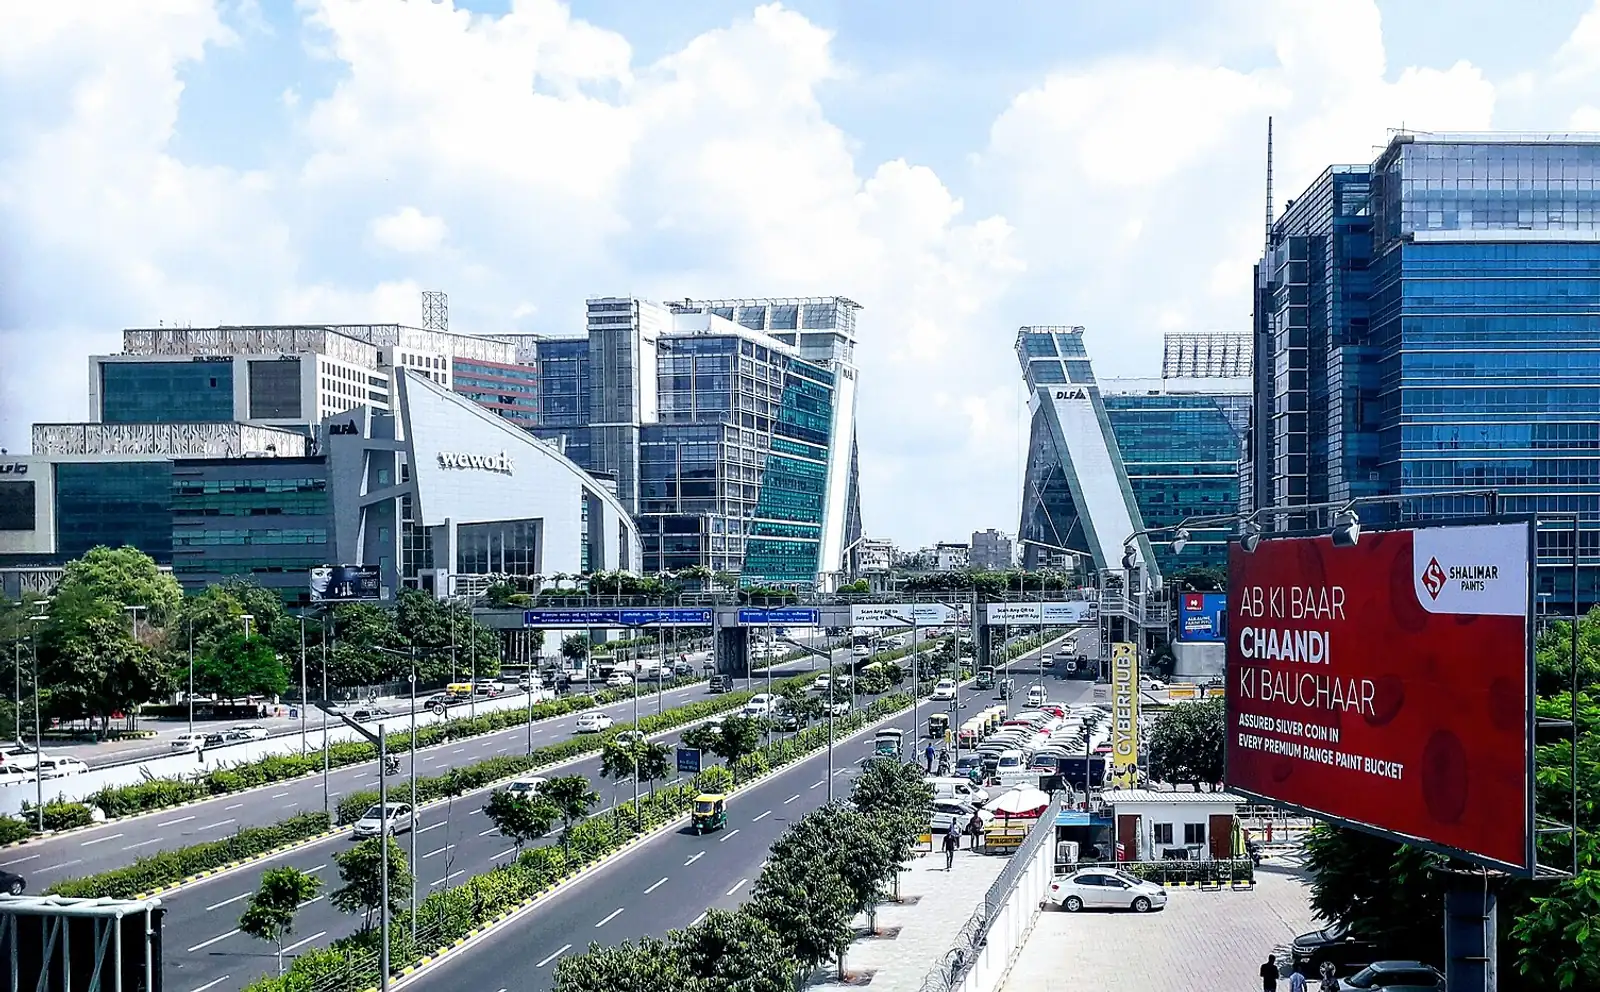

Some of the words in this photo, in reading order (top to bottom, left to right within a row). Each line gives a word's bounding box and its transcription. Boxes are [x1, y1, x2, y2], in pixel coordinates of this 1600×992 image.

[1056, 391, 1076, 400] DLF
[438, 449, 514, 472] wework
[1449, 566, 1498, 580] SHALIMAR
[1461, 580, 1485, 591] PAINTS
[1240, 586, 1264, 617] AB
[1269, 586, 1285, 618] KI
[1291, 586, 1346, 620] BAAR
[1240, 626, 1330, 665] CHAANDI
[1117, 656, 1132, 756] CYBERHUB
[1240, 667, 1255, 698] KI
[1261, 669, 1375, 716] BAUCHAAR
[1239, 713, 1275, 731] ASSURED
[1276, 719, 1303, 737] SILVER
[1304, 723, 1327, 741] COIN
[1329, 727, 1339, 743] IN
[1238, 733, 1263, 750] EVERY
[1264, 738, 1301, 759] PREMIUM
[1303, 746, 1333, 765] RANGE
[1335, 752, 1363, 771] PAINT
[1364, 757, 1403, 780] BUCKET
